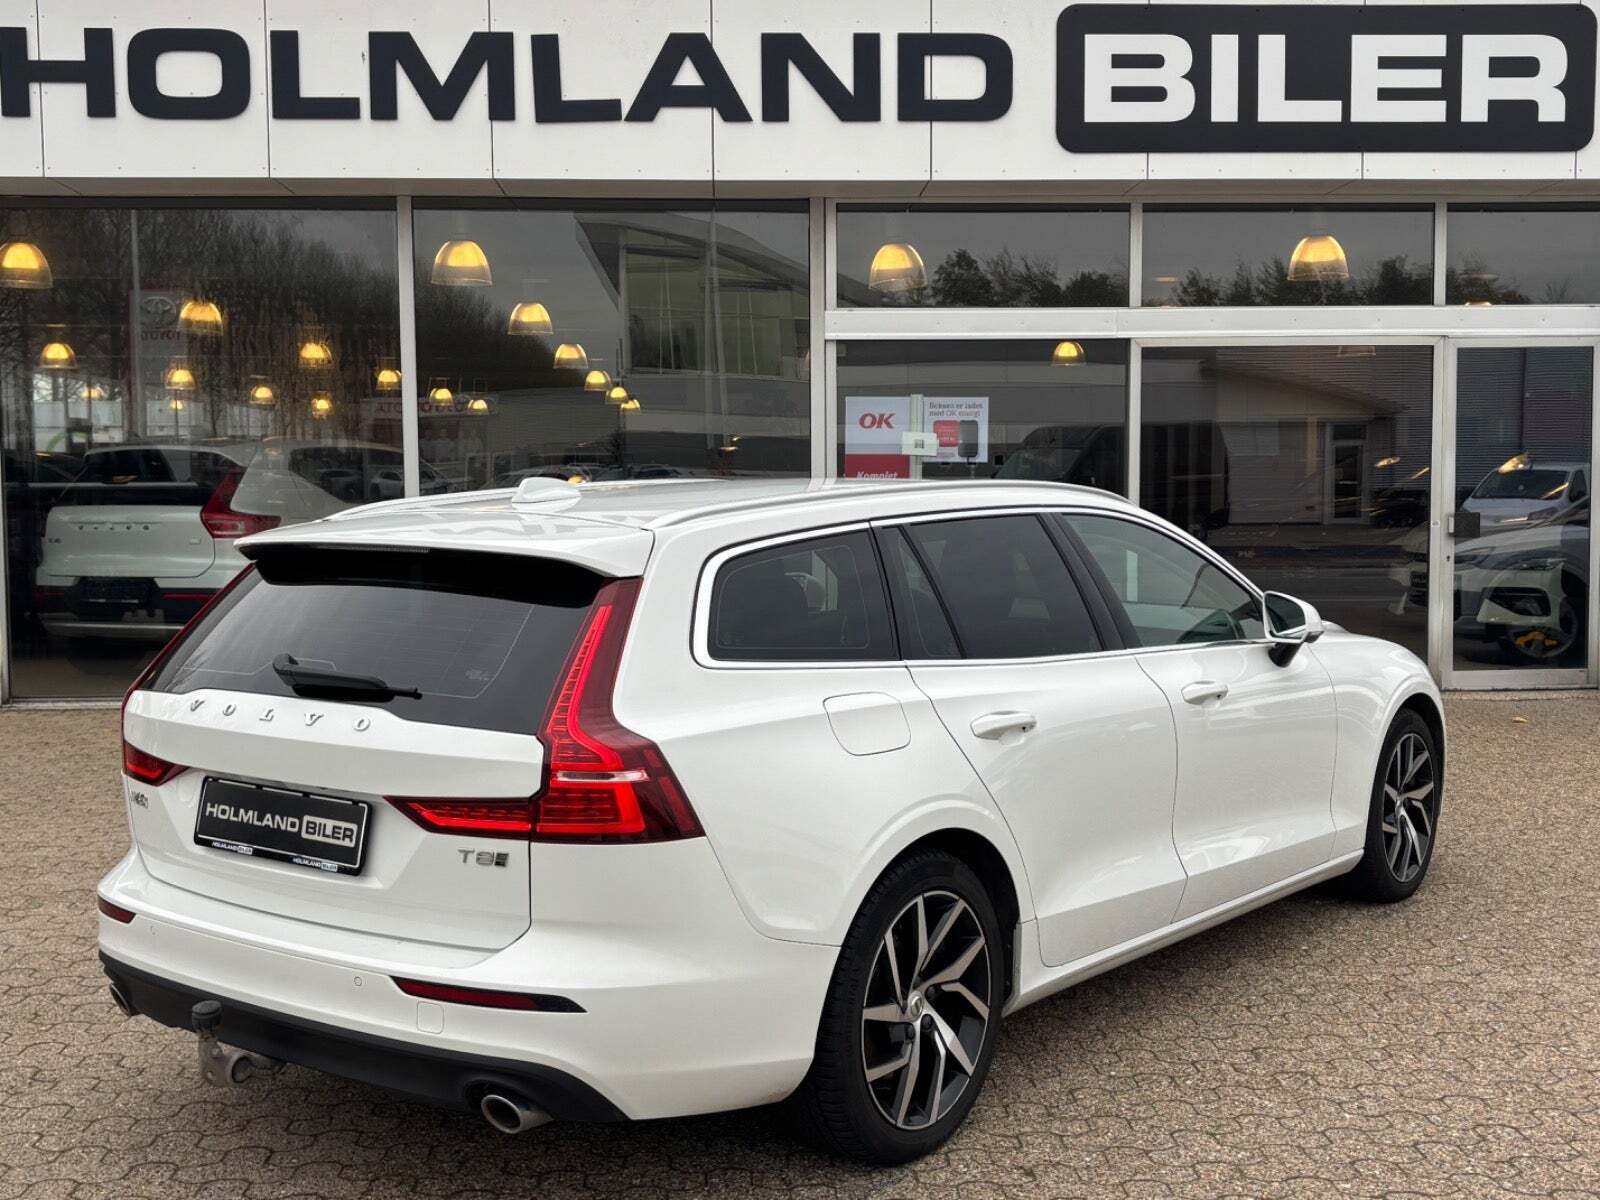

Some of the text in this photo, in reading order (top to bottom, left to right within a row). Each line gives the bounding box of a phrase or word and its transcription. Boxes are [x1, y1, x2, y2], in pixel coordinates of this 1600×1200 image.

[0, 26, 1569, 123] HOLMLAND BILER
[859, 412, 896, 429] OK
[188, 698, 372, 733] VOLVO
[205, 802, 355, 844] HOLMLAND BILER
